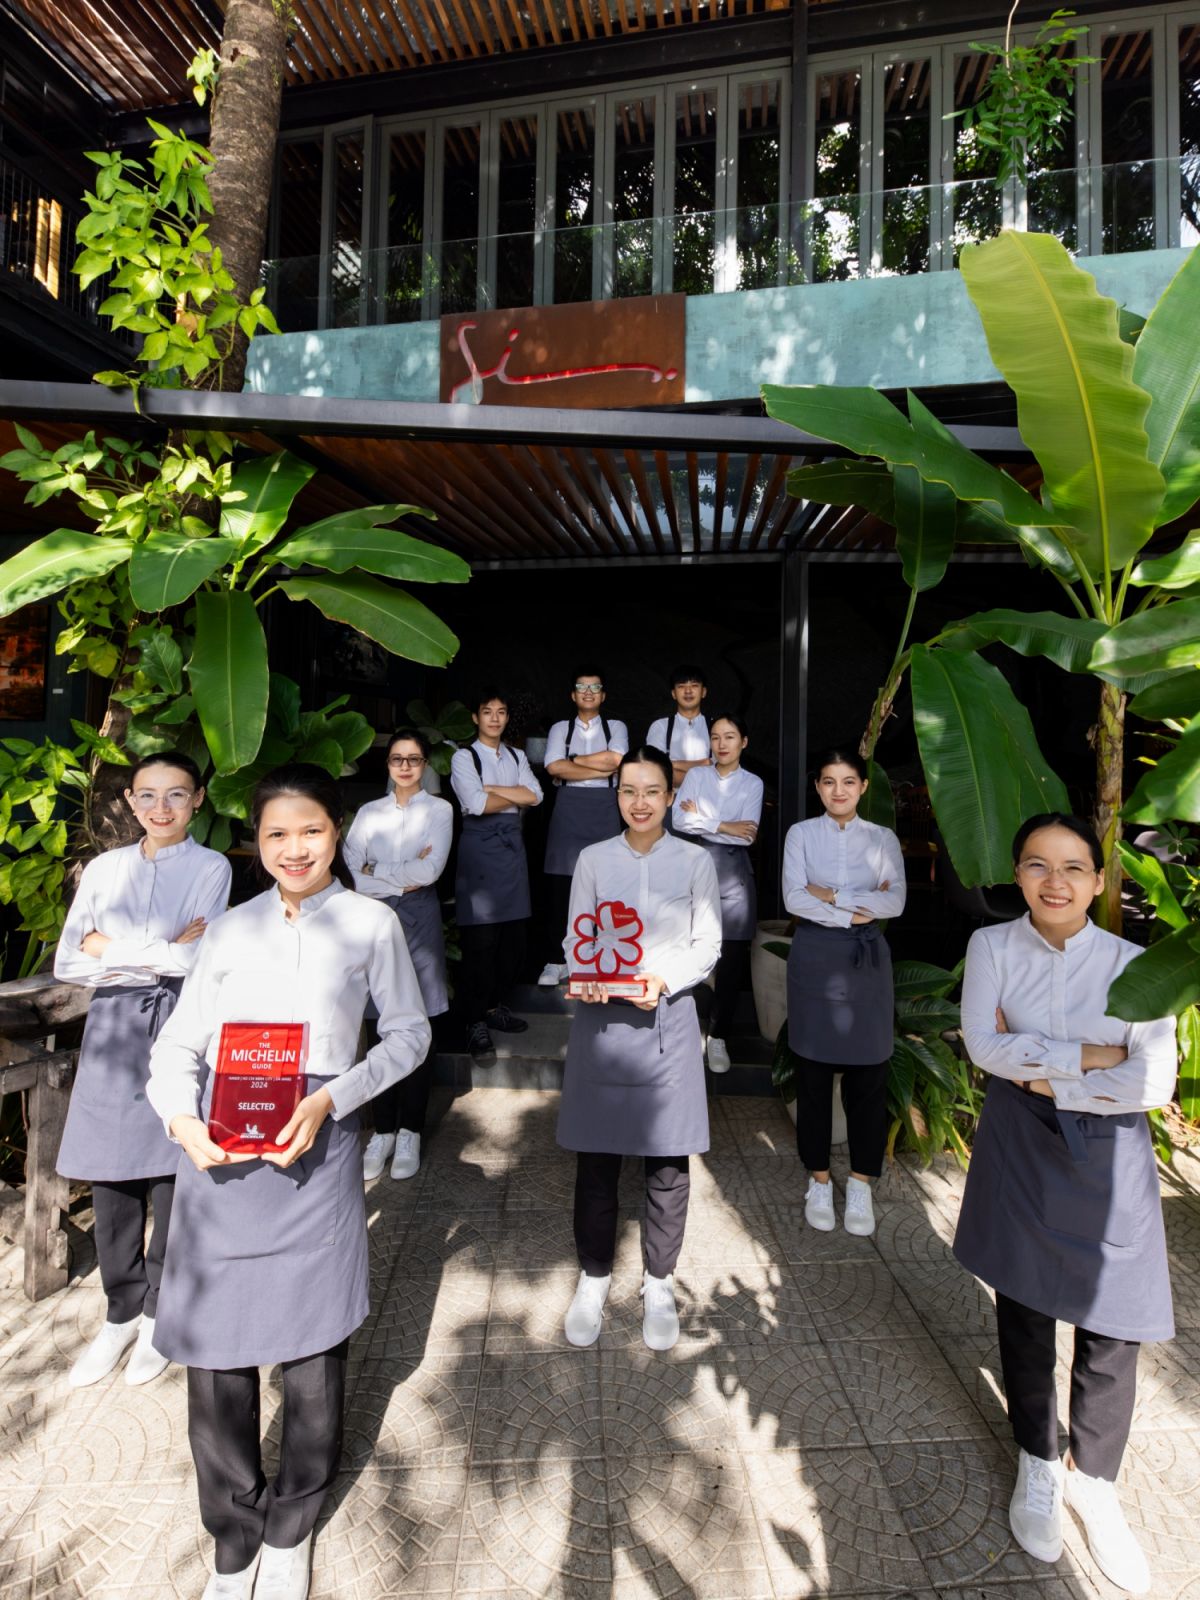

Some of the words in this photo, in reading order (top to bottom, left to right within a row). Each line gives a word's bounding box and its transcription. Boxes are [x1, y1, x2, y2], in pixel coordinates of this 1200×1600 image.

[231, 1049, 296, 1062] MICHELIN
[251, 1081, 268, 1089] 2024
[238, 1102, 275, 1111] SELECTED
